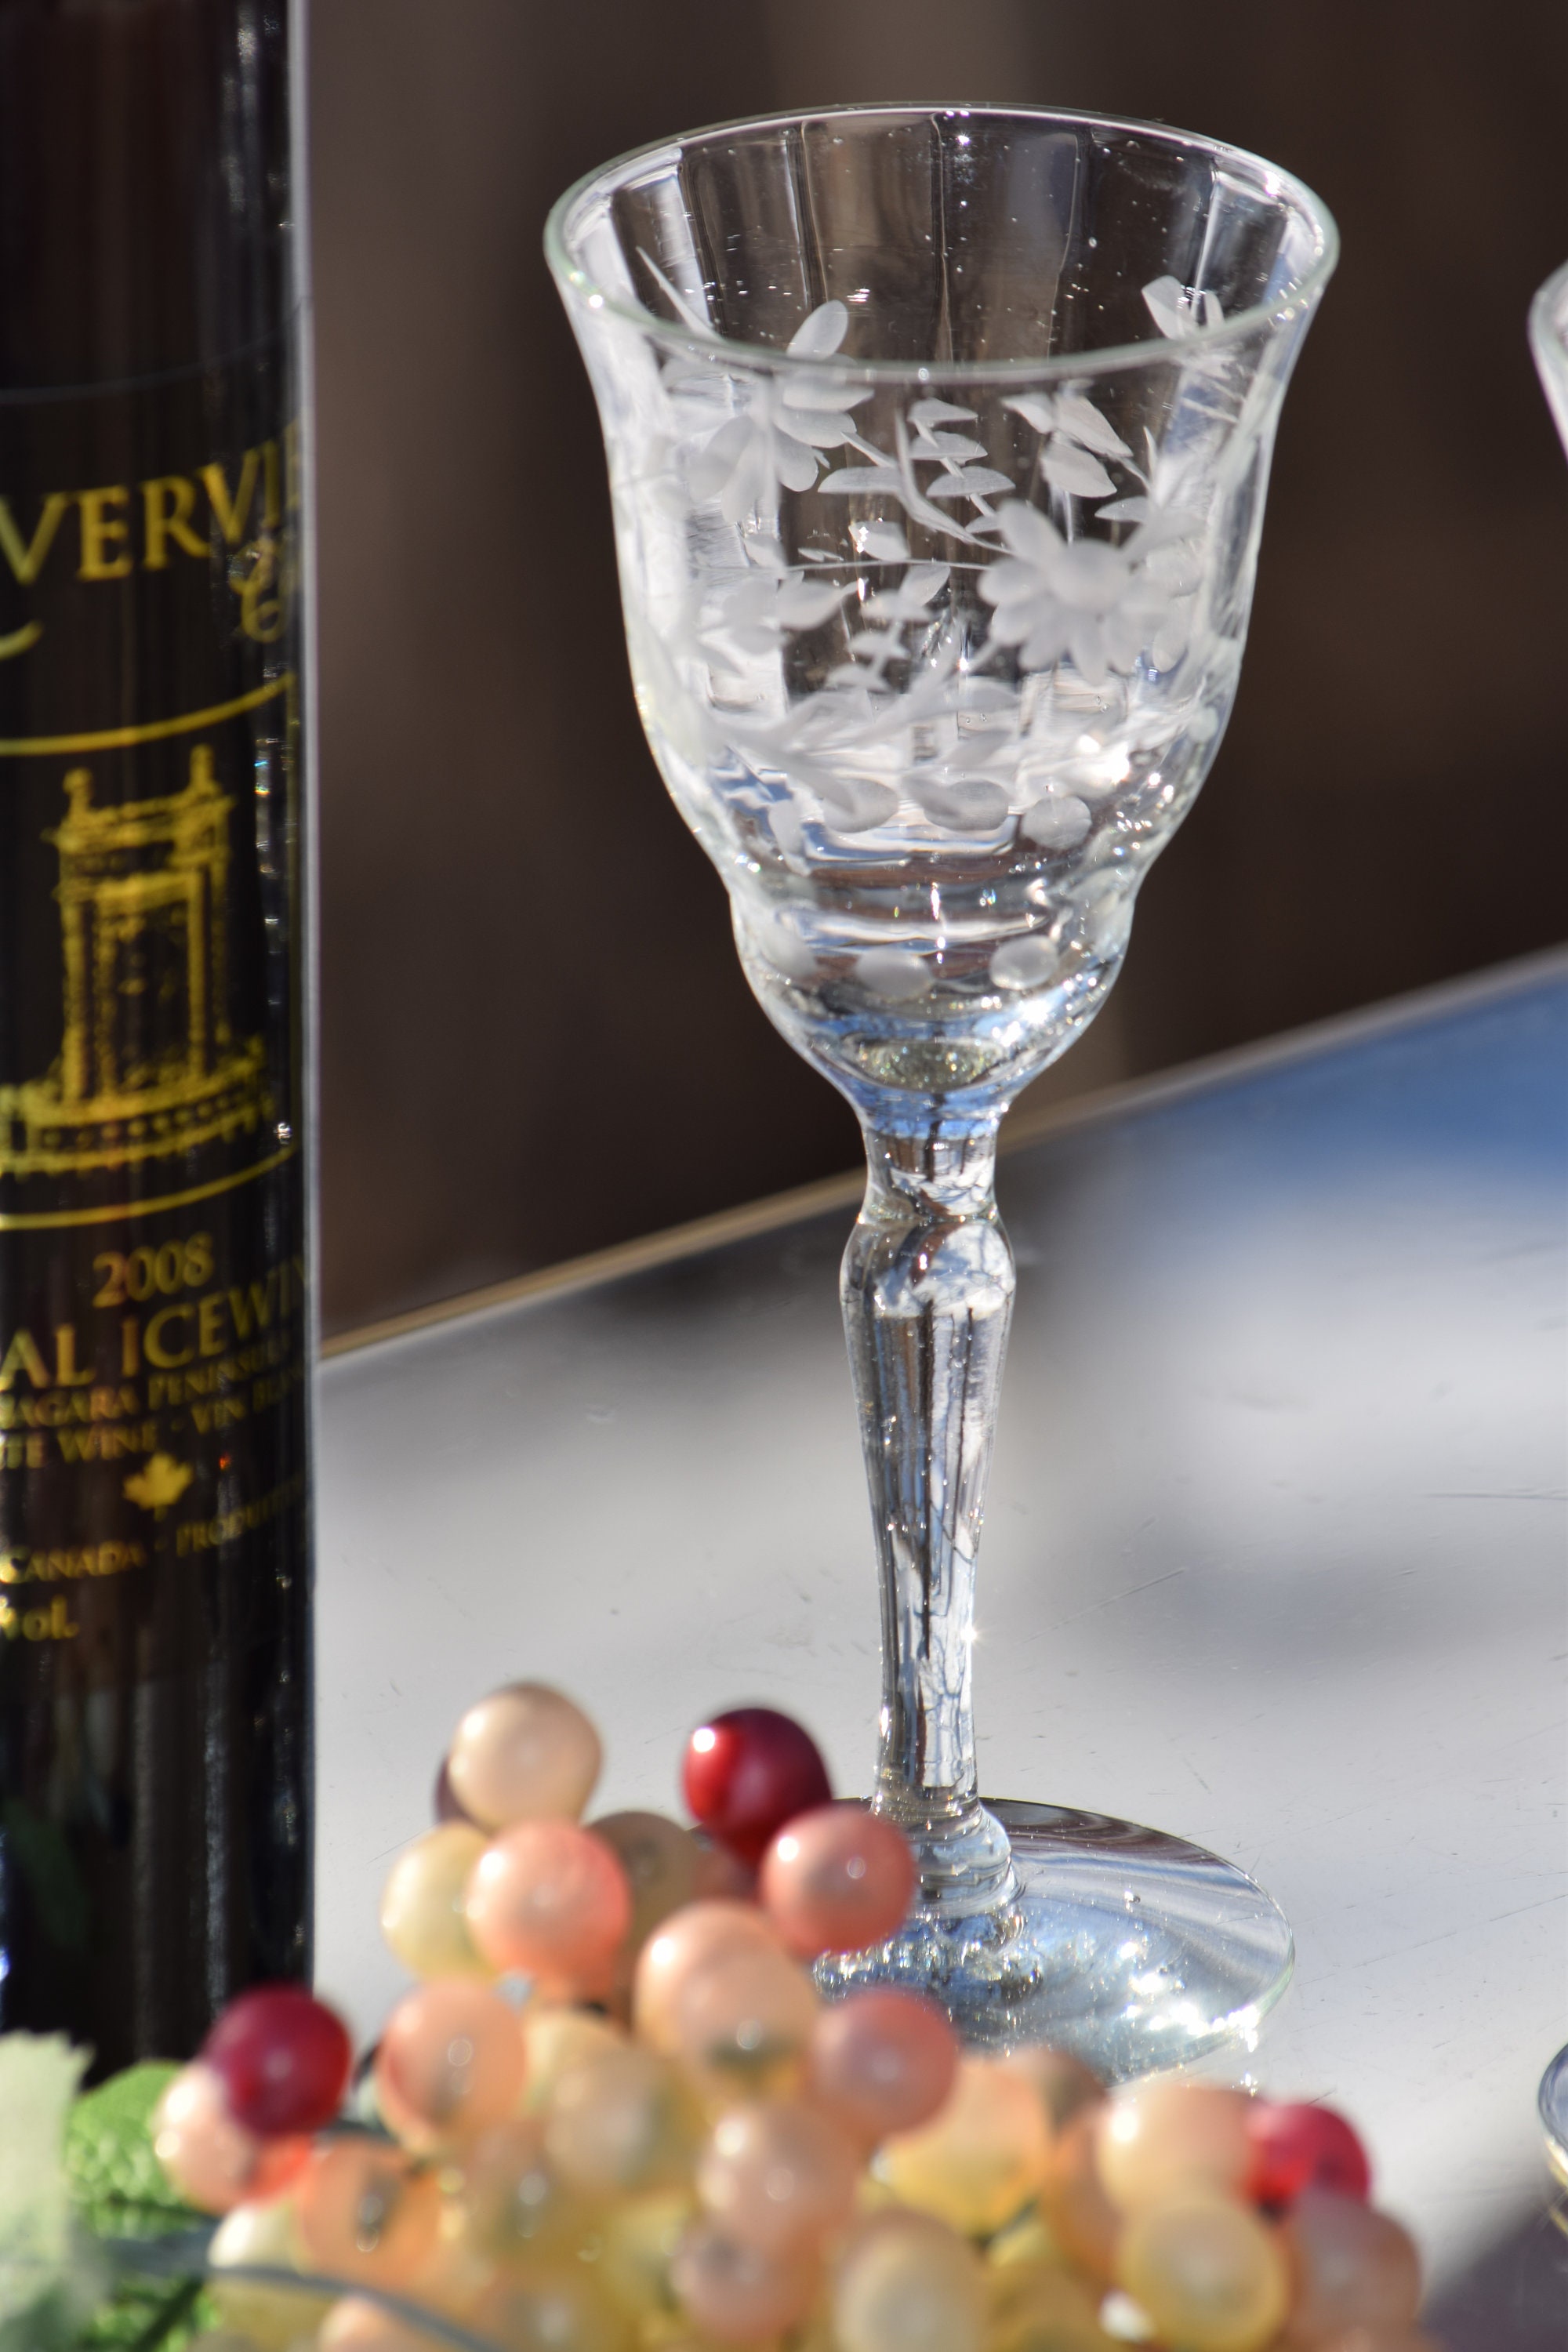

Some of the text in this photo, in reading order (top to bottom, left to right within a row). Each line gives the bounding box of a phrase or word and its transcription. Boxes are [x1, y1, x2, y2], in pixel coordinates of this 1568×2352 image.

[93, 1232, 215, 1308] 2008
[0, 1323, 96, 1391] AL
[58, 1418, 157, 1464] WINE
